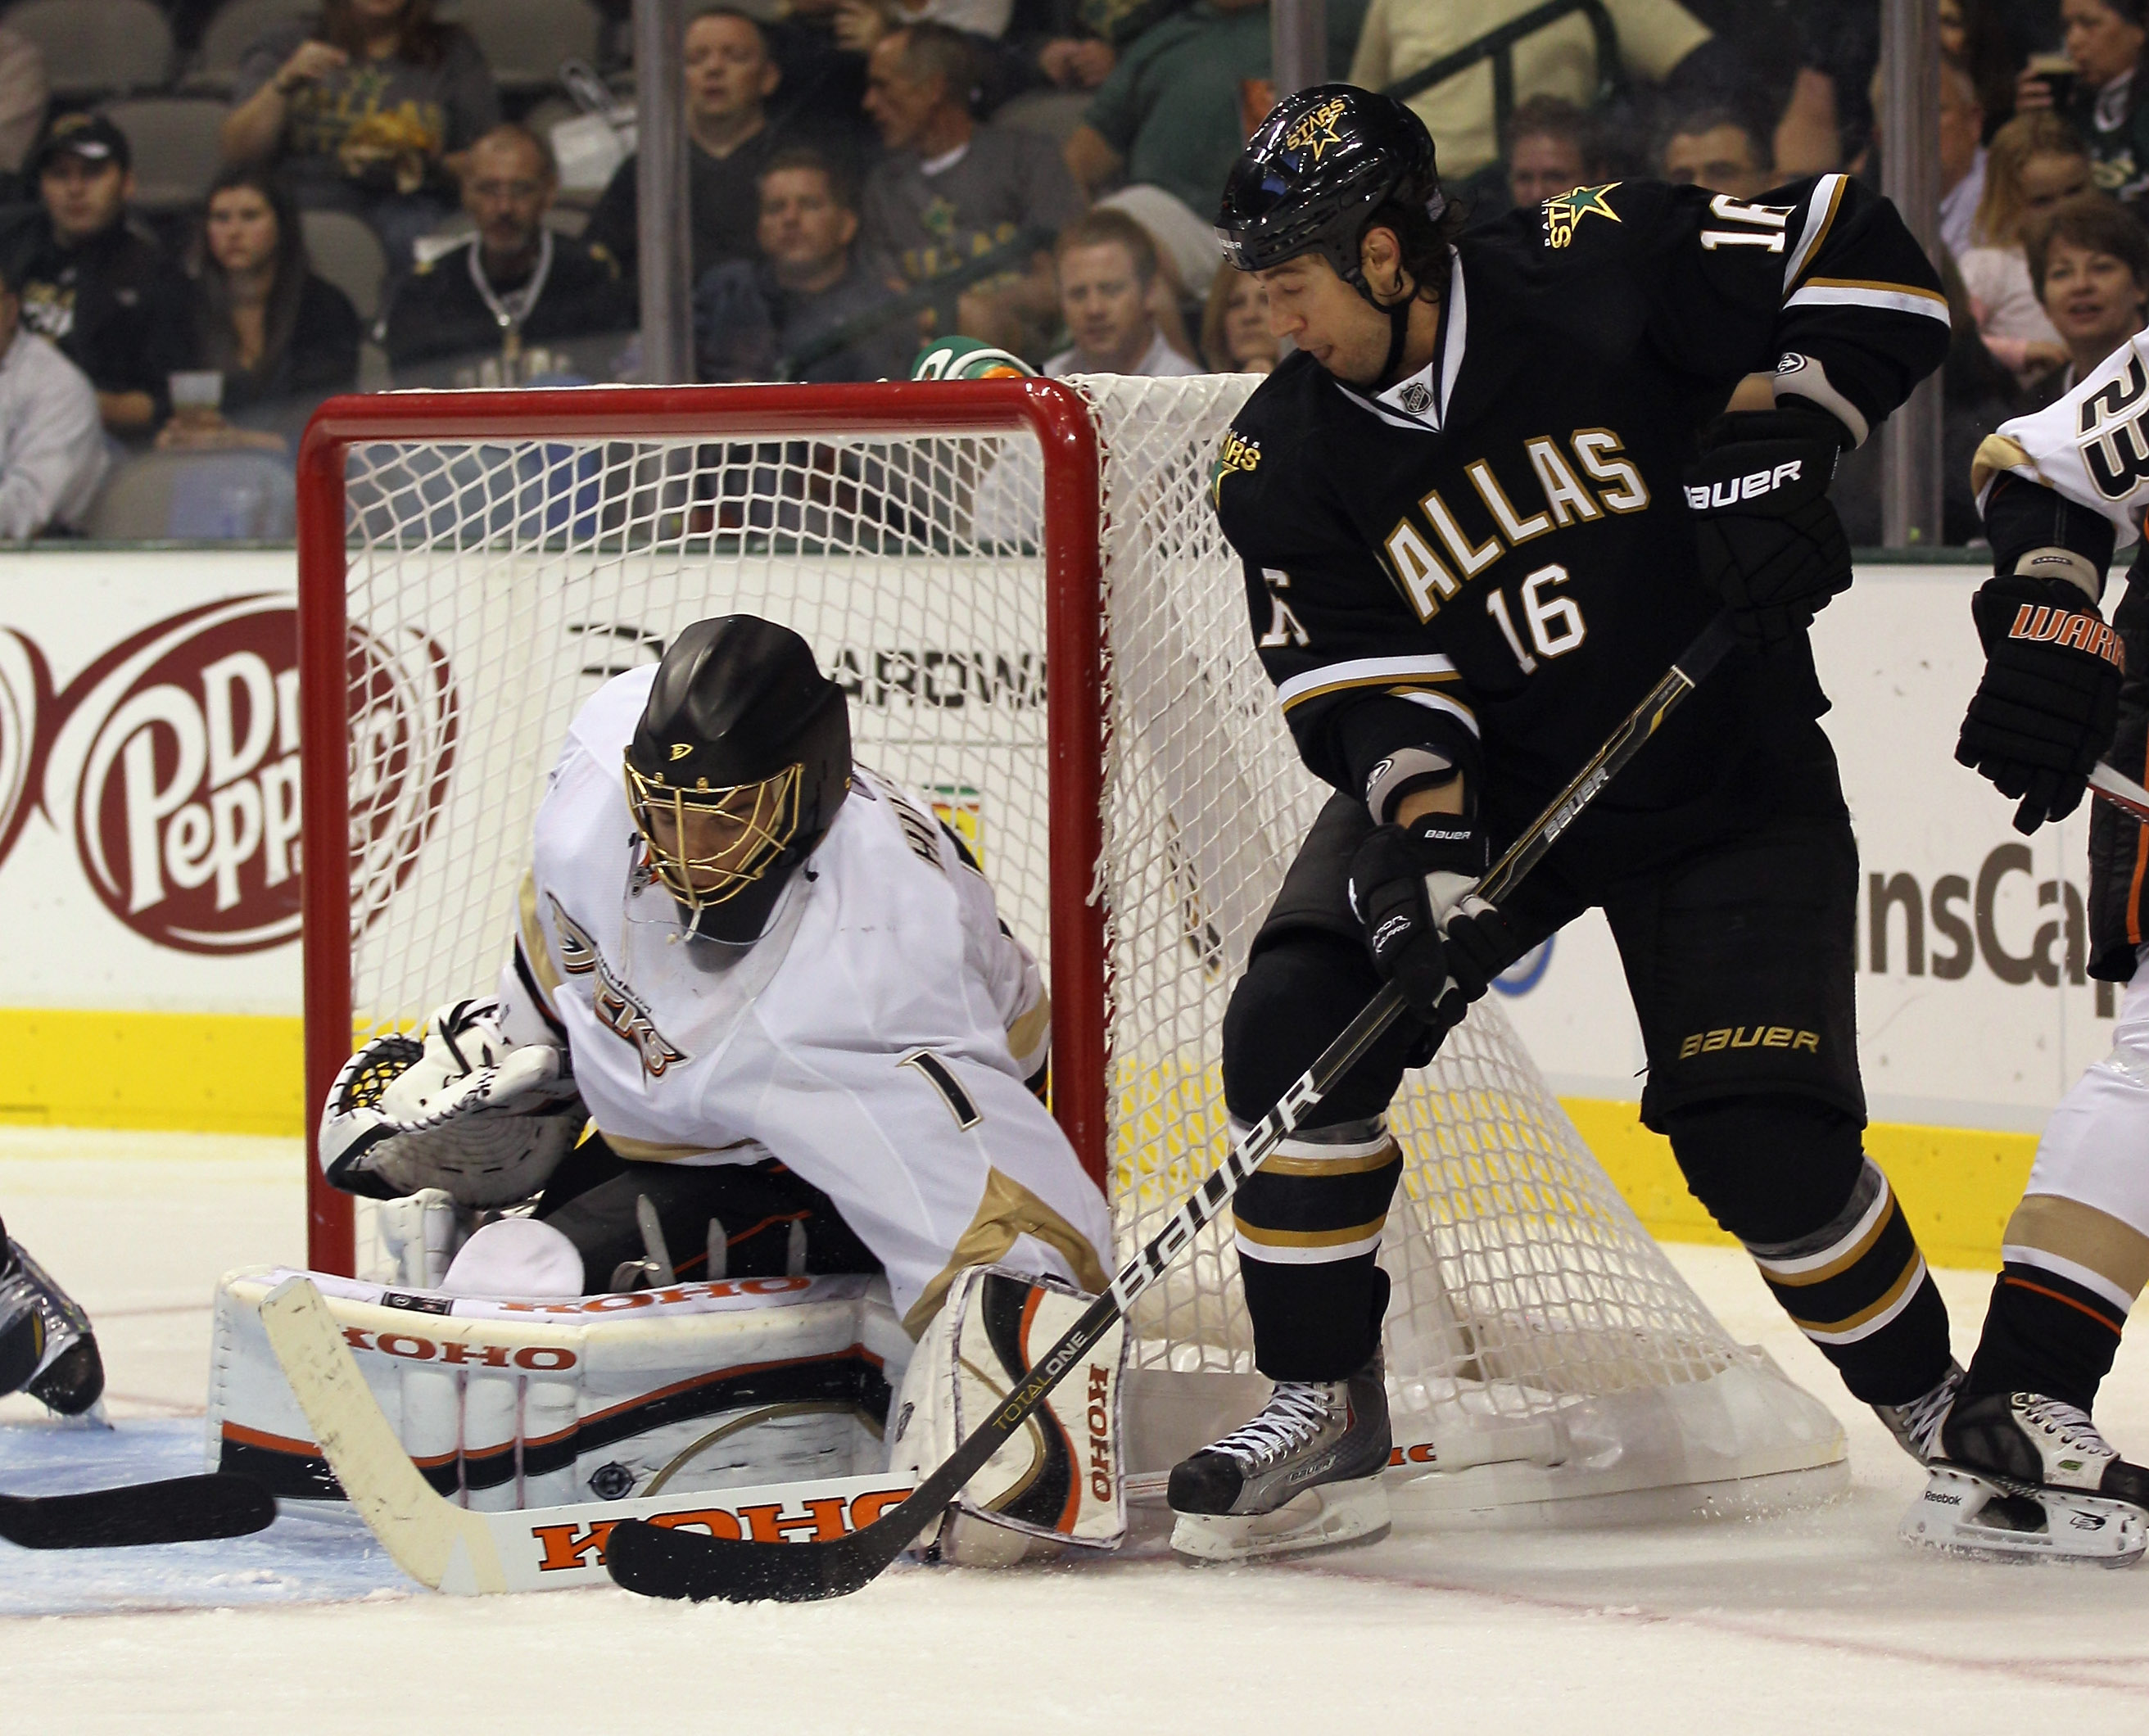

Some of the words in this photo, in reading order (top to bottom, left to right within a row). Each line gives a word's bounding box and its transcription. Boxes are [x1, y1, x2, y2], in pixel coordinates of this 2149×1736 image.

[1287, 99, 1346, 151] STARS
[1373, 427, 1651, 625] ALLAS
[1486, 563, 1588, 676] 16
[1424, 829, 1473, 840] BAUER
[1544, 766, 1609, 843] BAUER
[1854, 843, 2128, 1018] nsCa
[1679, 1025, 1821, 1060] BAUER
[1110, 1069, 1324, 1313] BAUER
[1088, 1363, 1111, 1503] KOHO
[1925, 1490, 1962, 1506] Reebok
